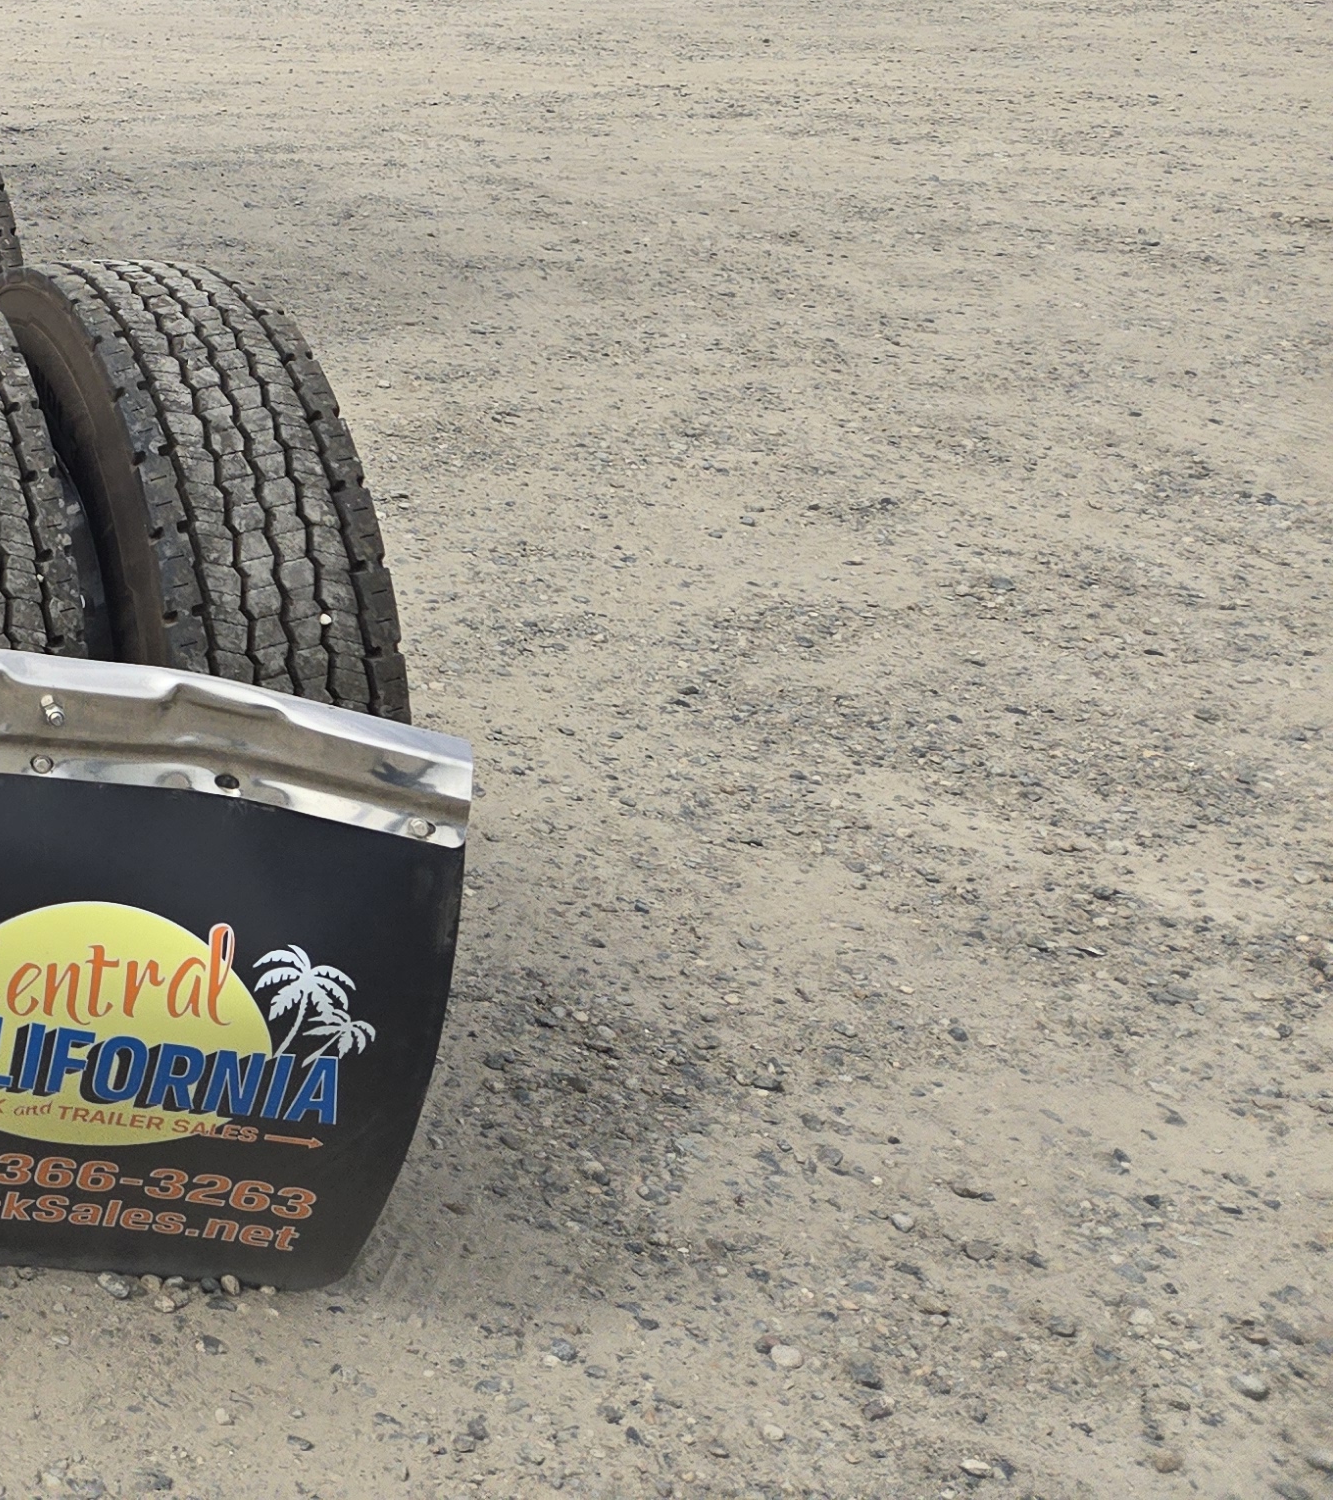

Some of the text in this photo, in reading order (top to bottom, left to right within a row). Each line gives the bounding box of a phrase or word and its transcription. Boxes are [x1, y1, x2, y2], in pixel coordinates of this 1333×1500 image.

[13, 1099, 53, 1118] and
[58, 1105, 163, 1132] TRAILER
[172, 1118, 260, 1144] SALES
